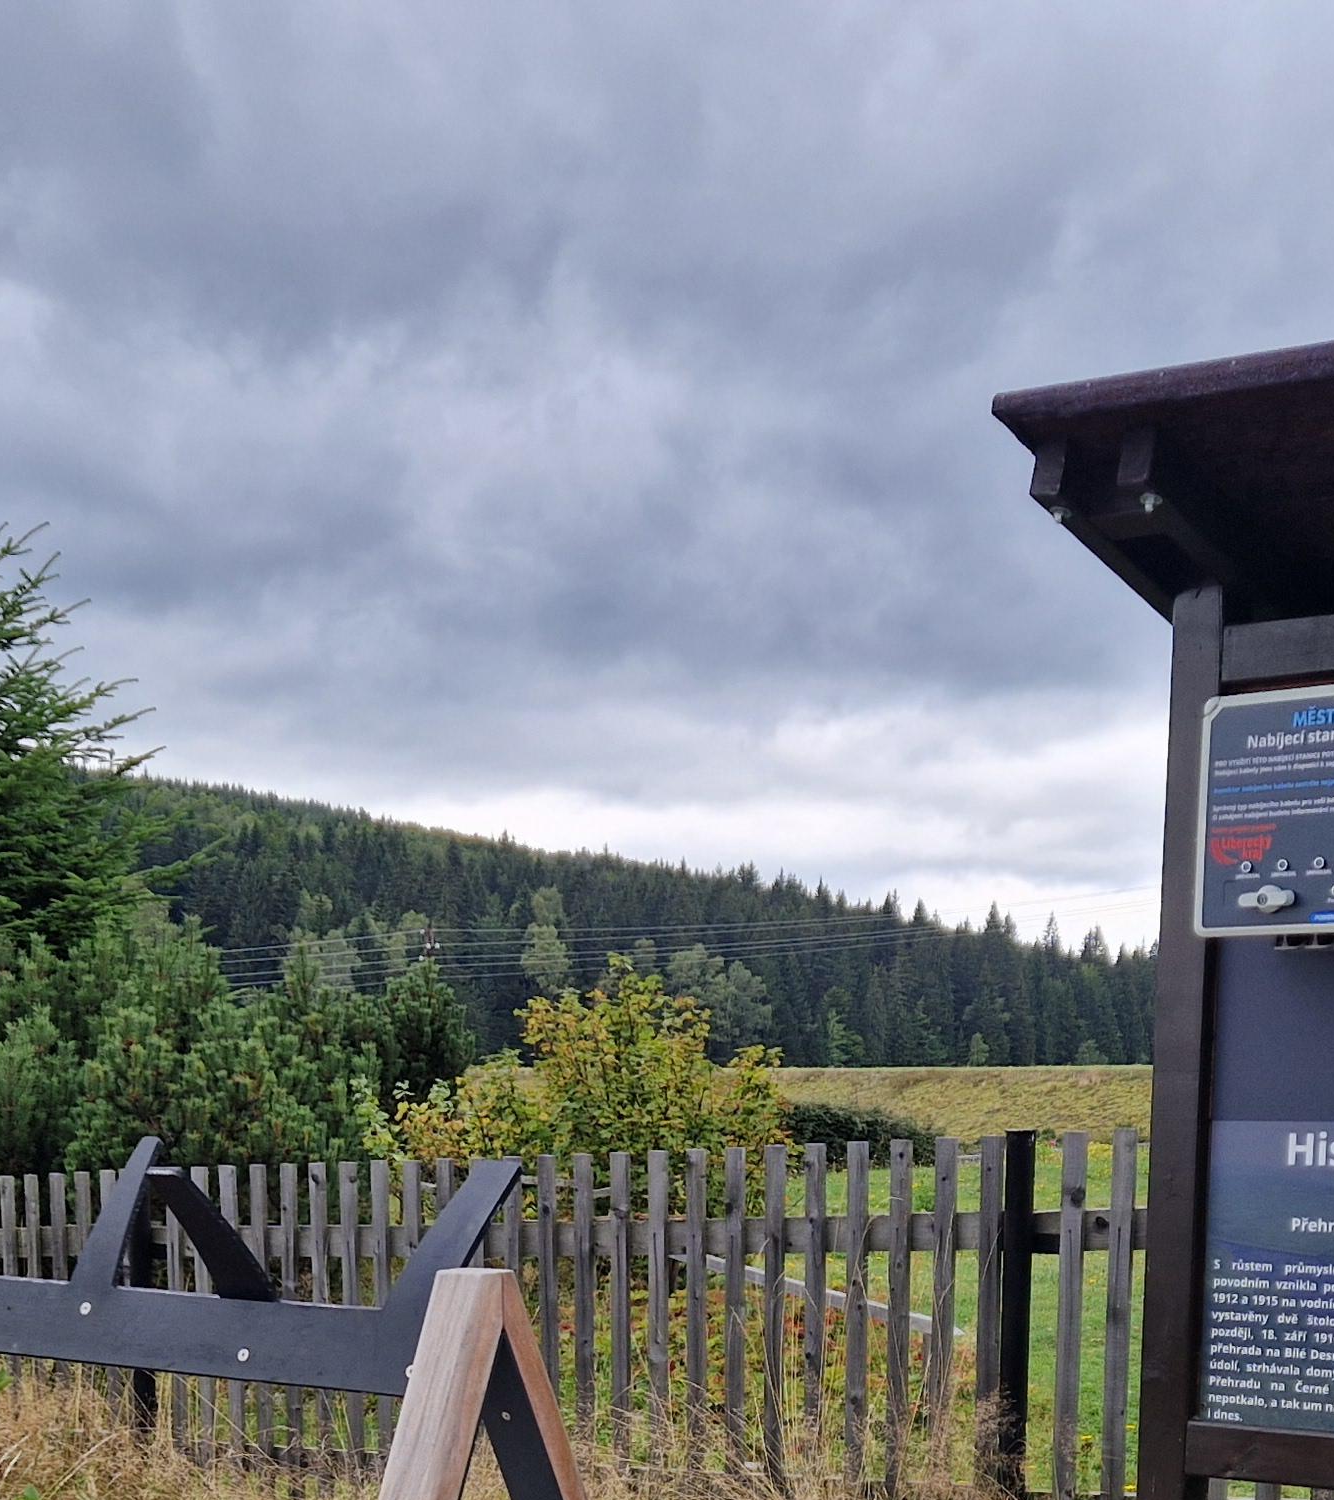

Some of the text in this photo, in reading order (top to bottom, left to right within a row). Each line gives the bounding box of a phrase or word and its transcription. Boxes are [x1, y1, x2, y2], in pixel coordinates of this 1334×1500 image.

[1247, 729, 1304, 749] Nabíjecí
[1213, 1277, 1269, 1289] povodním
[1275, 1279, 1316, 1291] vznikla
[1213, 1294, 1238, 1304] 1912
[1241, 1297, 1248, 1305] a
[1251, 1295, 1278, 1306] 1915
[1280, 1298, 1296, 1307] na
[1211, 1311, 1268, 1325] vystavěny
[1277, 1313, 1298, 1325] dvě
[1284, 1330, 1306, 1342] září
[1208, 1376, 1260, 1390] Přehradu
[1270, 1383, 1285, 1392] na
[1294, 1381, 1329, 1395] Černé
[1270, 1400, 1277, 1408] a
[1280, 1398, 1300, 1410] tak
[1302, 1402, 1322, 1411] um
